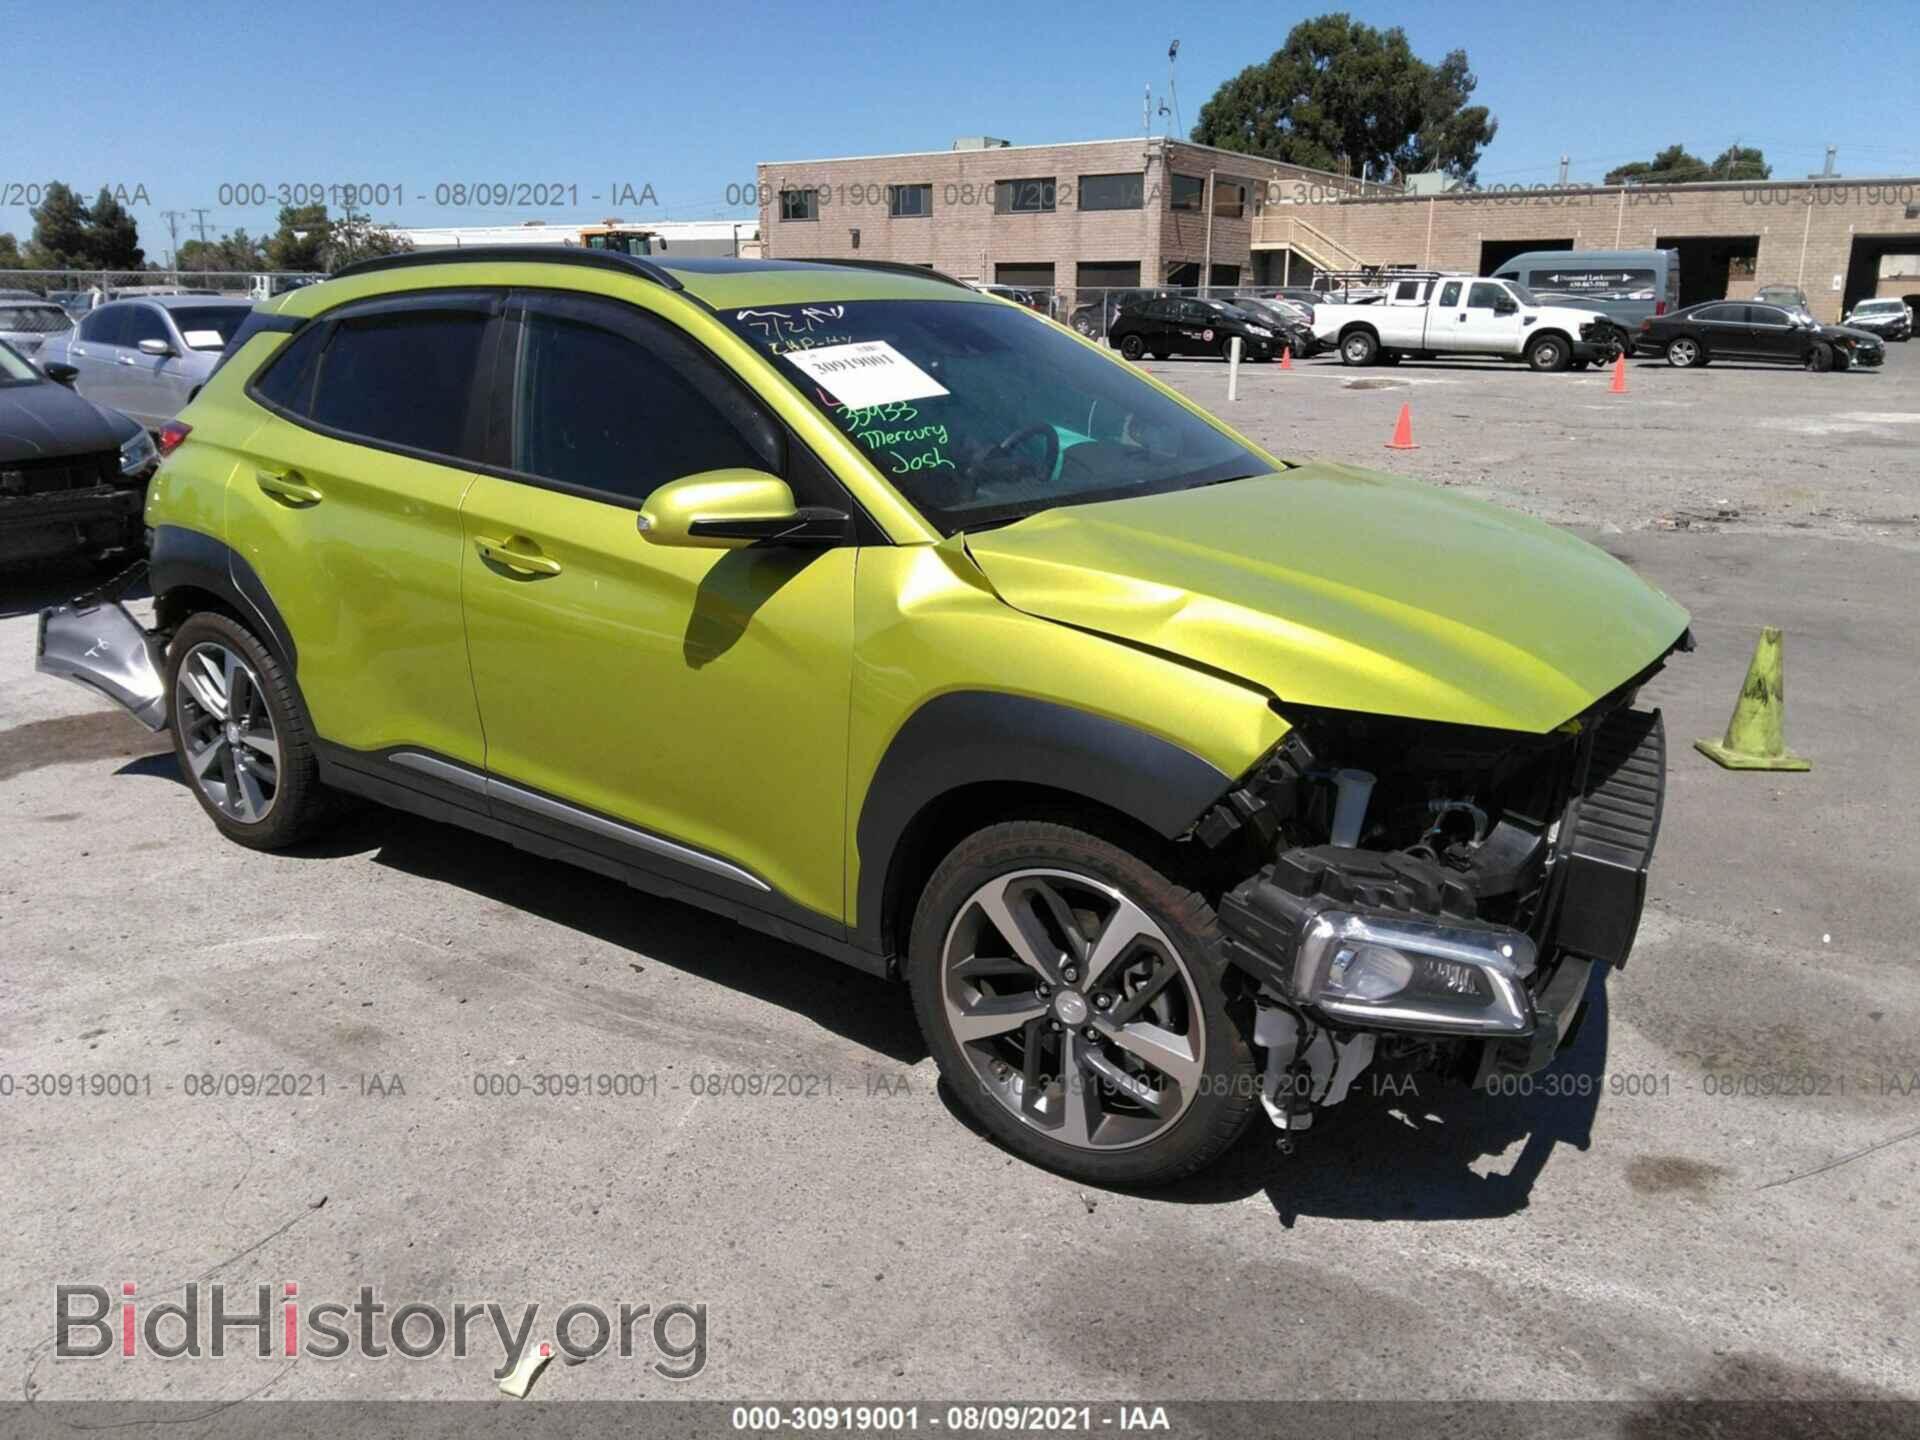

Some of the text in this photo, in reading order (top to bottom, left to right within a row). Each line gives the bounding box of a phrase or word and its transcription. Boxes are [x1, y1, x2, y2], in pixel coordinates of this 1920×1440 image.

[811, 353, 895, 375] 30919001
[857, 424, 948, 450] Mercury
[889, 447, 956, 473] Josh
